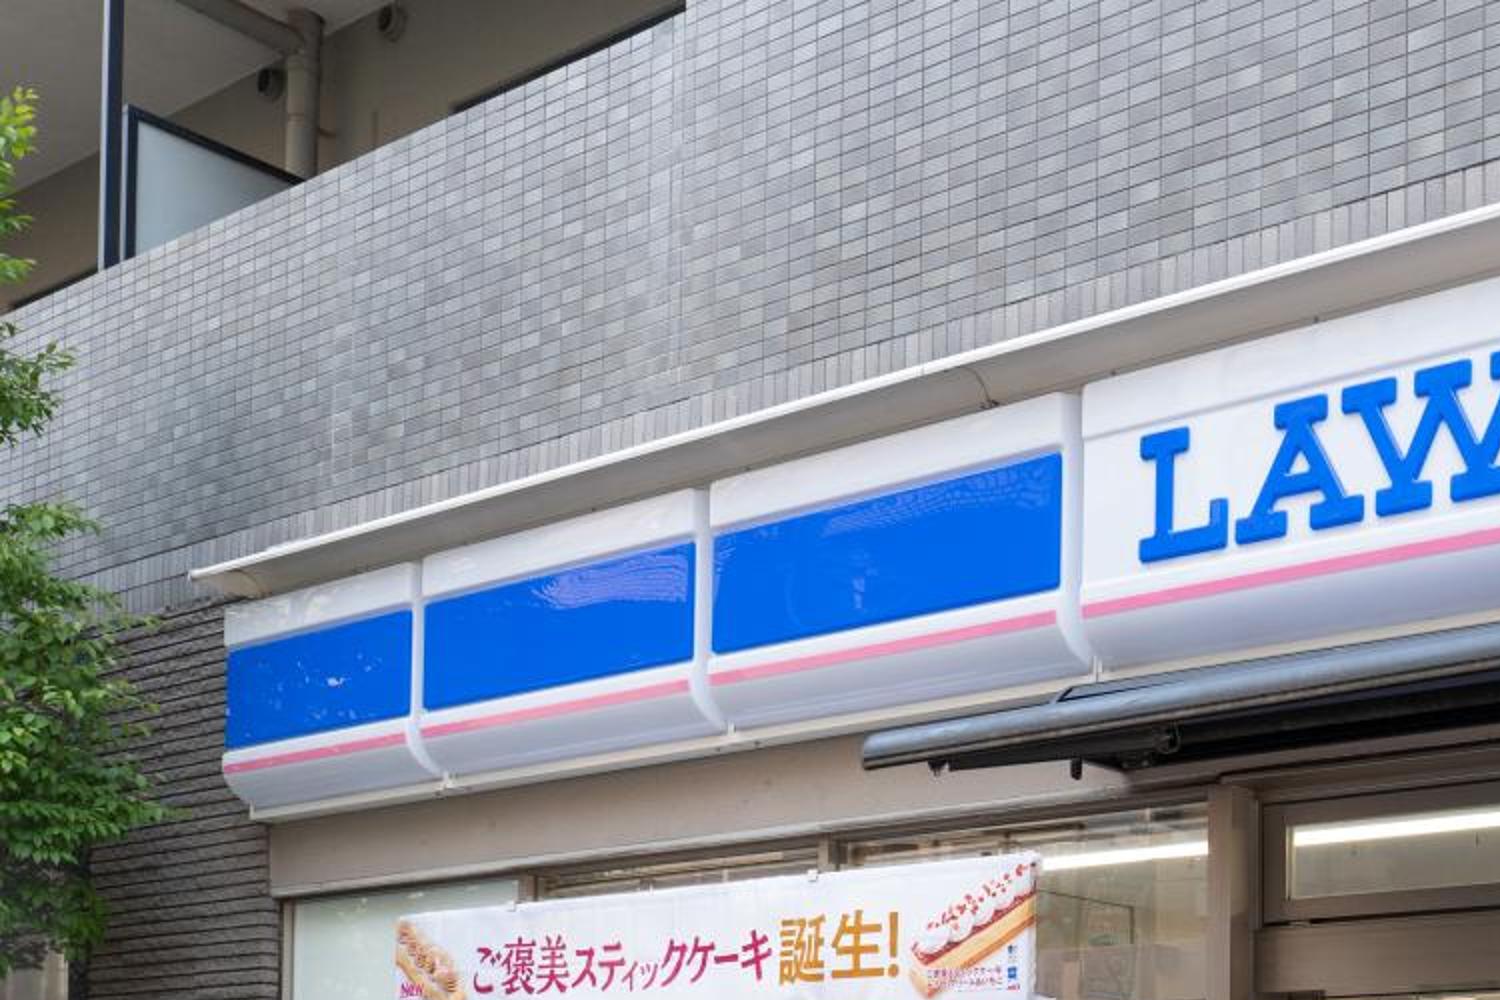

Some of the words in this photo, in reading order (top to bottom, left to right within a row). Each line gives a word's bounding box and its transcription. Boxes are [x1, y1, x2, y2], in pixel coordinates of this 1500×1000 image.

[472, 930, 773, 997] ご褒美スティックケーキ
[779, 908, 900, 987] 誕生!
